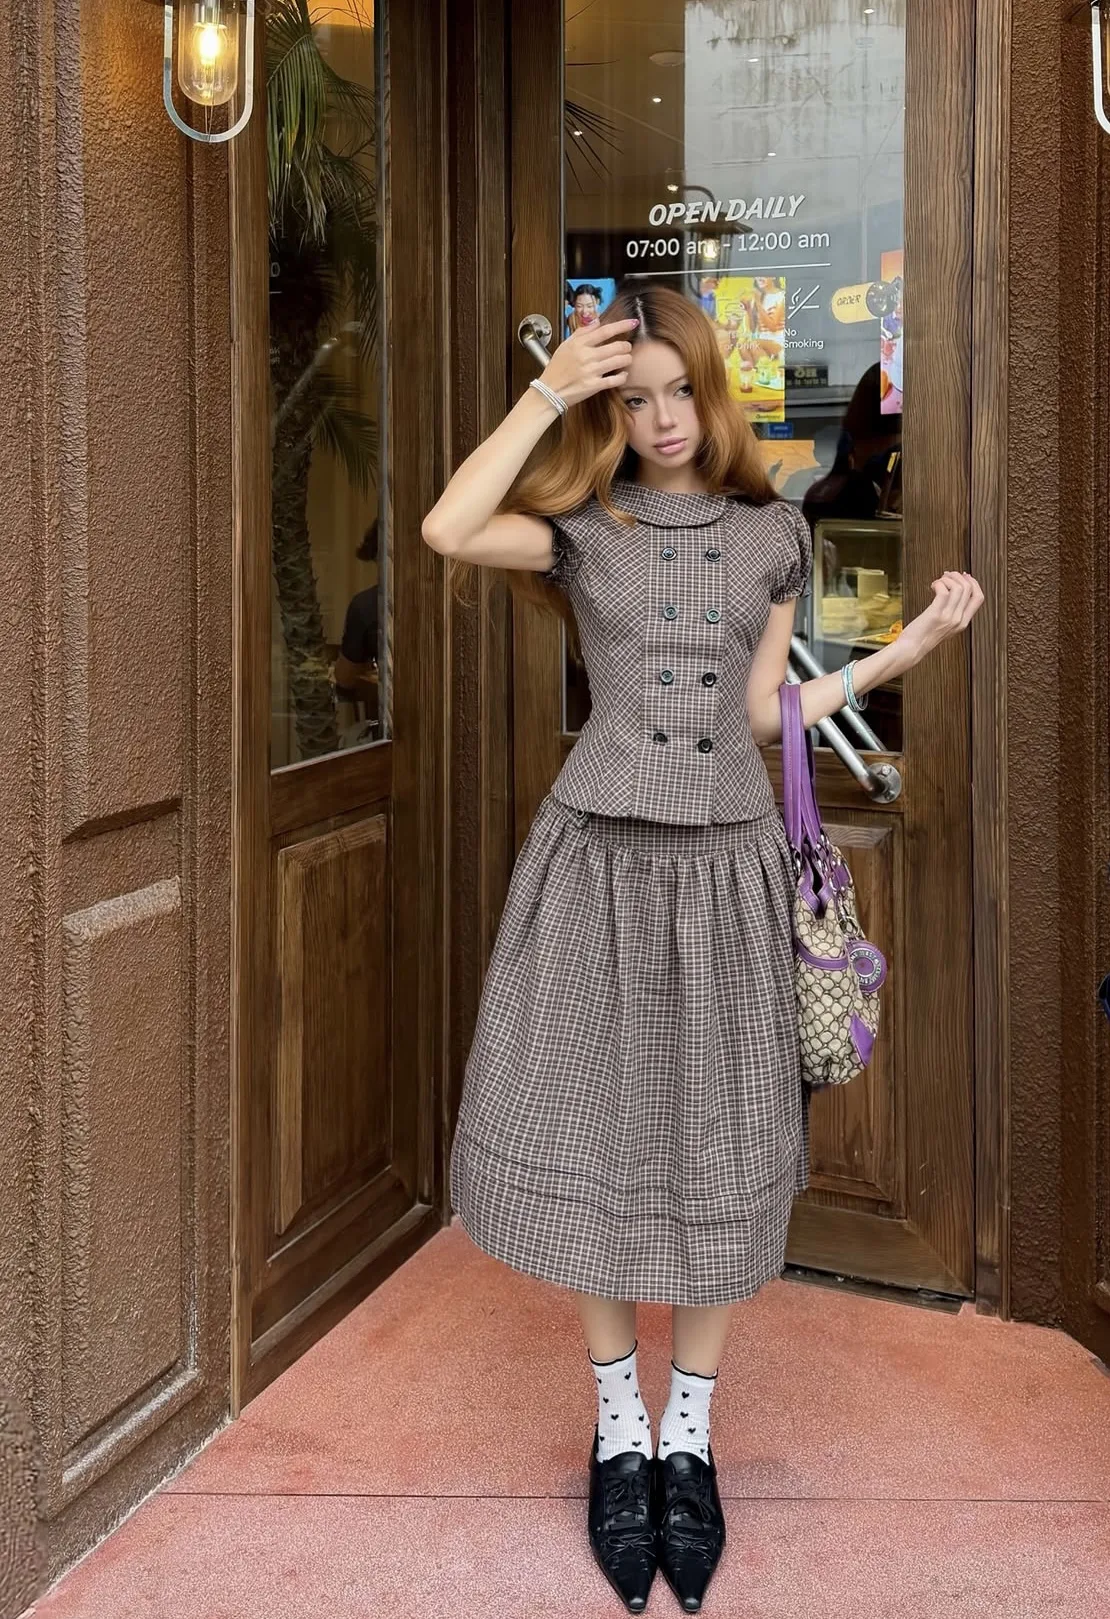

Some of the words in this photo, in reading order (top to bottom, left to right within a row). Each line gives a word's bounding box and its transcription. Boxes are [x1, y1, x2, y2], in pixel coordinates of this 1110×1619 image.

[648, 200, 722, 227] OPEN
[724, 194, 806, 222] DAILY
[626, 238, 680, 258] 07:00
[737, 231, 793, 252] 12:00
[797, 232, 830, 249] am
[784, 328, 798, 337] No
[784, 338, 824, 350] Smoking
